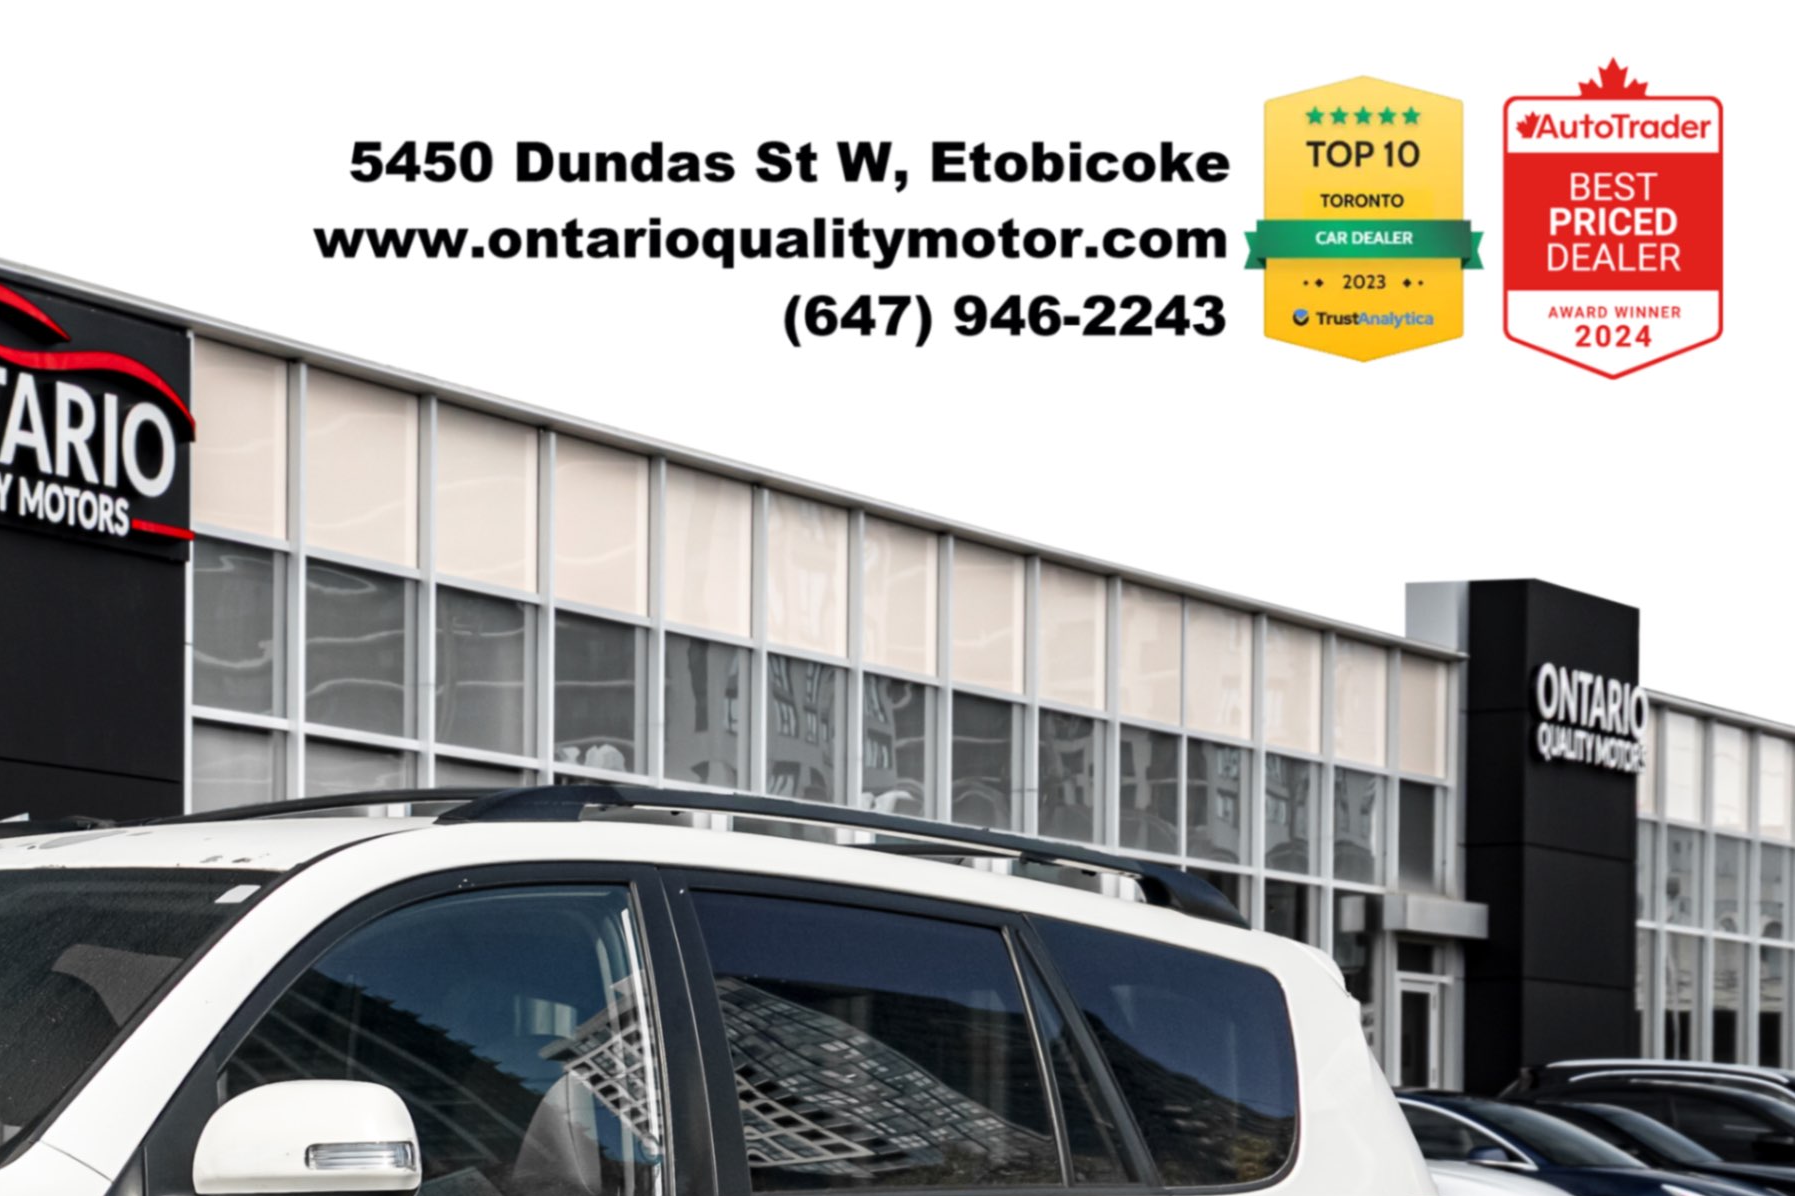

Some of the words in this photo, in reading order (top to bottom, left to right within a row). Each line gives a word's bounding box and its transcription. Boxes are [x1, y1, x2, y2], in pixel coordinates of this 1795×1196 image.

[19, 476, 130, 536] MOTORS
[1537, 662, 1648, 740] ONTARIO
[1537, 722, 1595, 763] QUALITY
[1594, 733, 1646, 773] MOTORS
